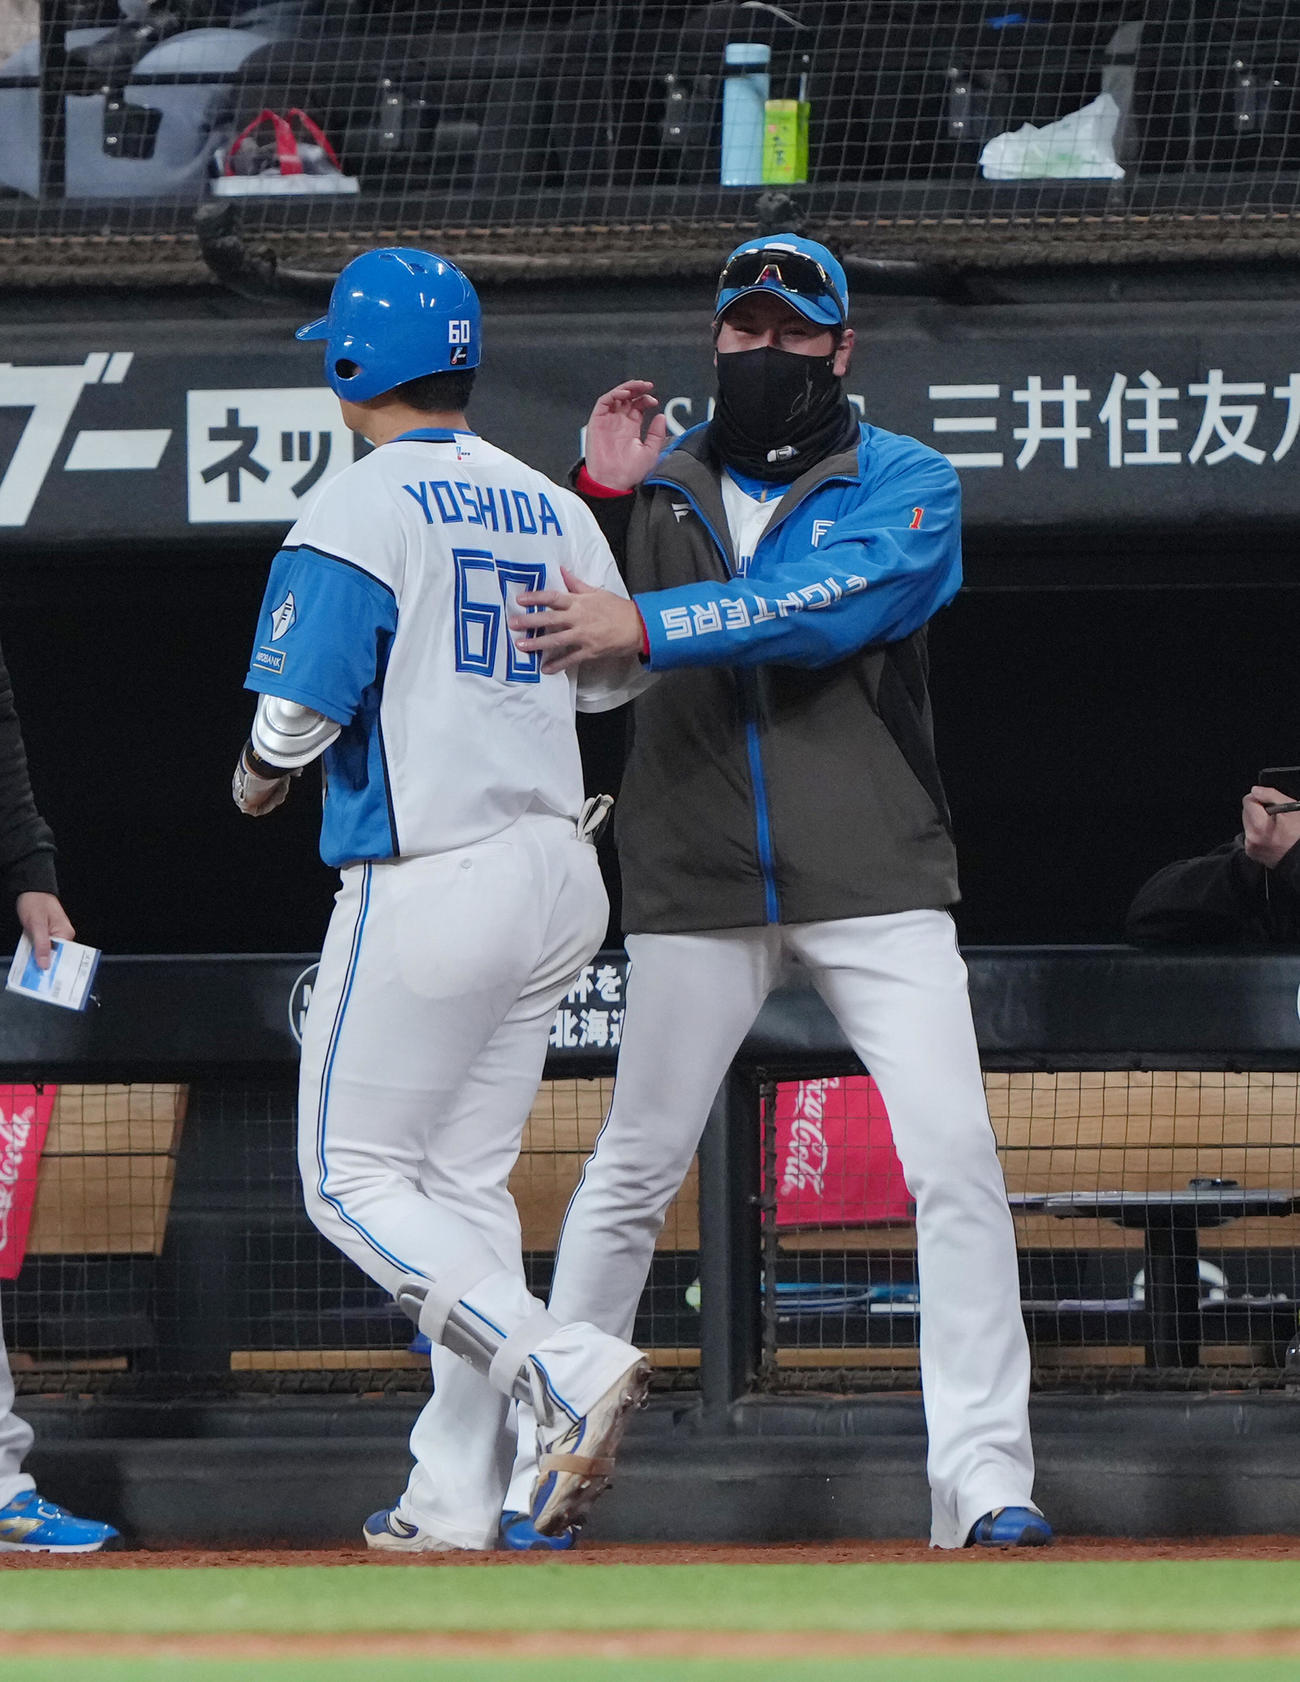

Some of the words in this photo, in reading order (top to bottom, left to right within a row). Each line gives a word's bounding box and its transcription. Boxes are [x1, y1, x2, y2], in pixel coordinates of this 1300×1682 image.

[448, 320, 470, 344] 60
[200, 408, 367, 503] ネッ
[402, 480, 563, 536] YOSHIDA
[909, 507, 924, 529] 1
[452, 548, 547, 683] 60
[660, 574, 868, 640] FIGHTERS
